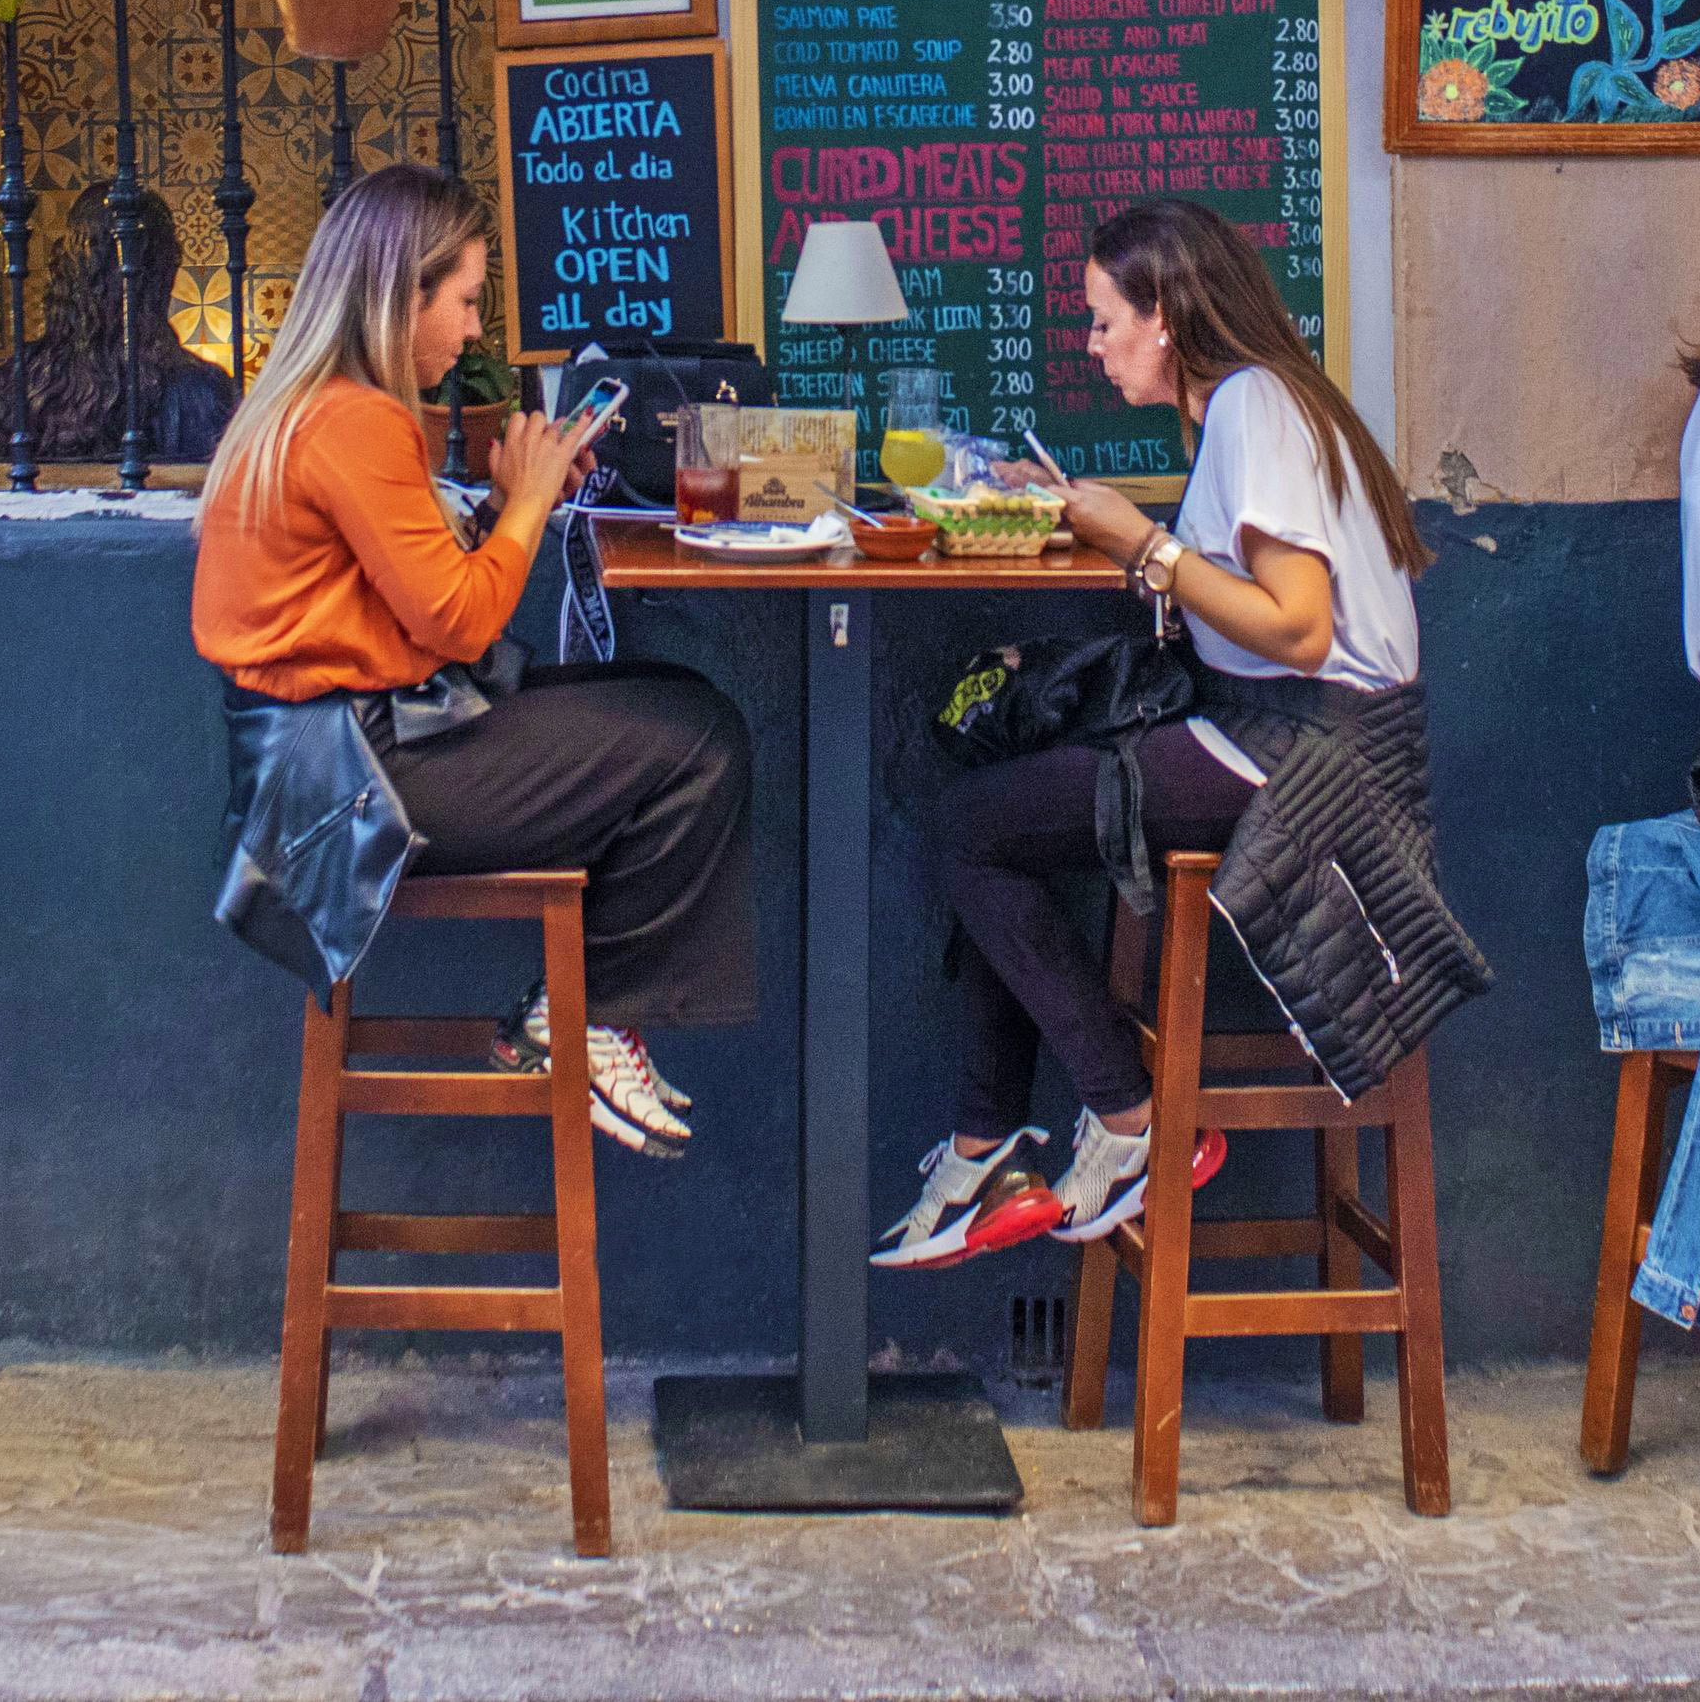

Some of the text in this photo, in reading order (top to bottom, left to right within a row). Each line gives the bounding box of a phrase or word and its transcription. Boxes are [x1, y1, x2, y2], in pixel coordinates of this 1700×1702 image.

[773, 6, 898, 30] SALMON PATE
[1123, 26, 1161, 48] AND
[1275, 18, 1318, 43] 2.80
[772, 38, 1033, 65] COLD TOMATO SOUP 2.80
[1271, 50, 1318, 72] 2.80
[545, 66, 650, 100] Cocina
[774, 72, 1033, 99] MELVA CANUTERA 3.00
[1139, 80, 1318, 107] SAUCE 2.80
[529, 100, 682, 144] ABIERTA
[843, 102, 1034, 130] EN ESCABECHE 3.00
[1275, 108, 1319, 131] 3.00
[518, 151, 584, 184] Todo
[771, 141, 1027, 204] CURED MEATS
[561, 200, 690, 244] Kitchen
[871, 205, 1024, 262] CHEESE
[555, 246, 669, 284] OPEN
[604, 289, 673, 336] day
[868, 337, 936, 363] CHEESE
[1093, 439, 1170, 472] MEATS
